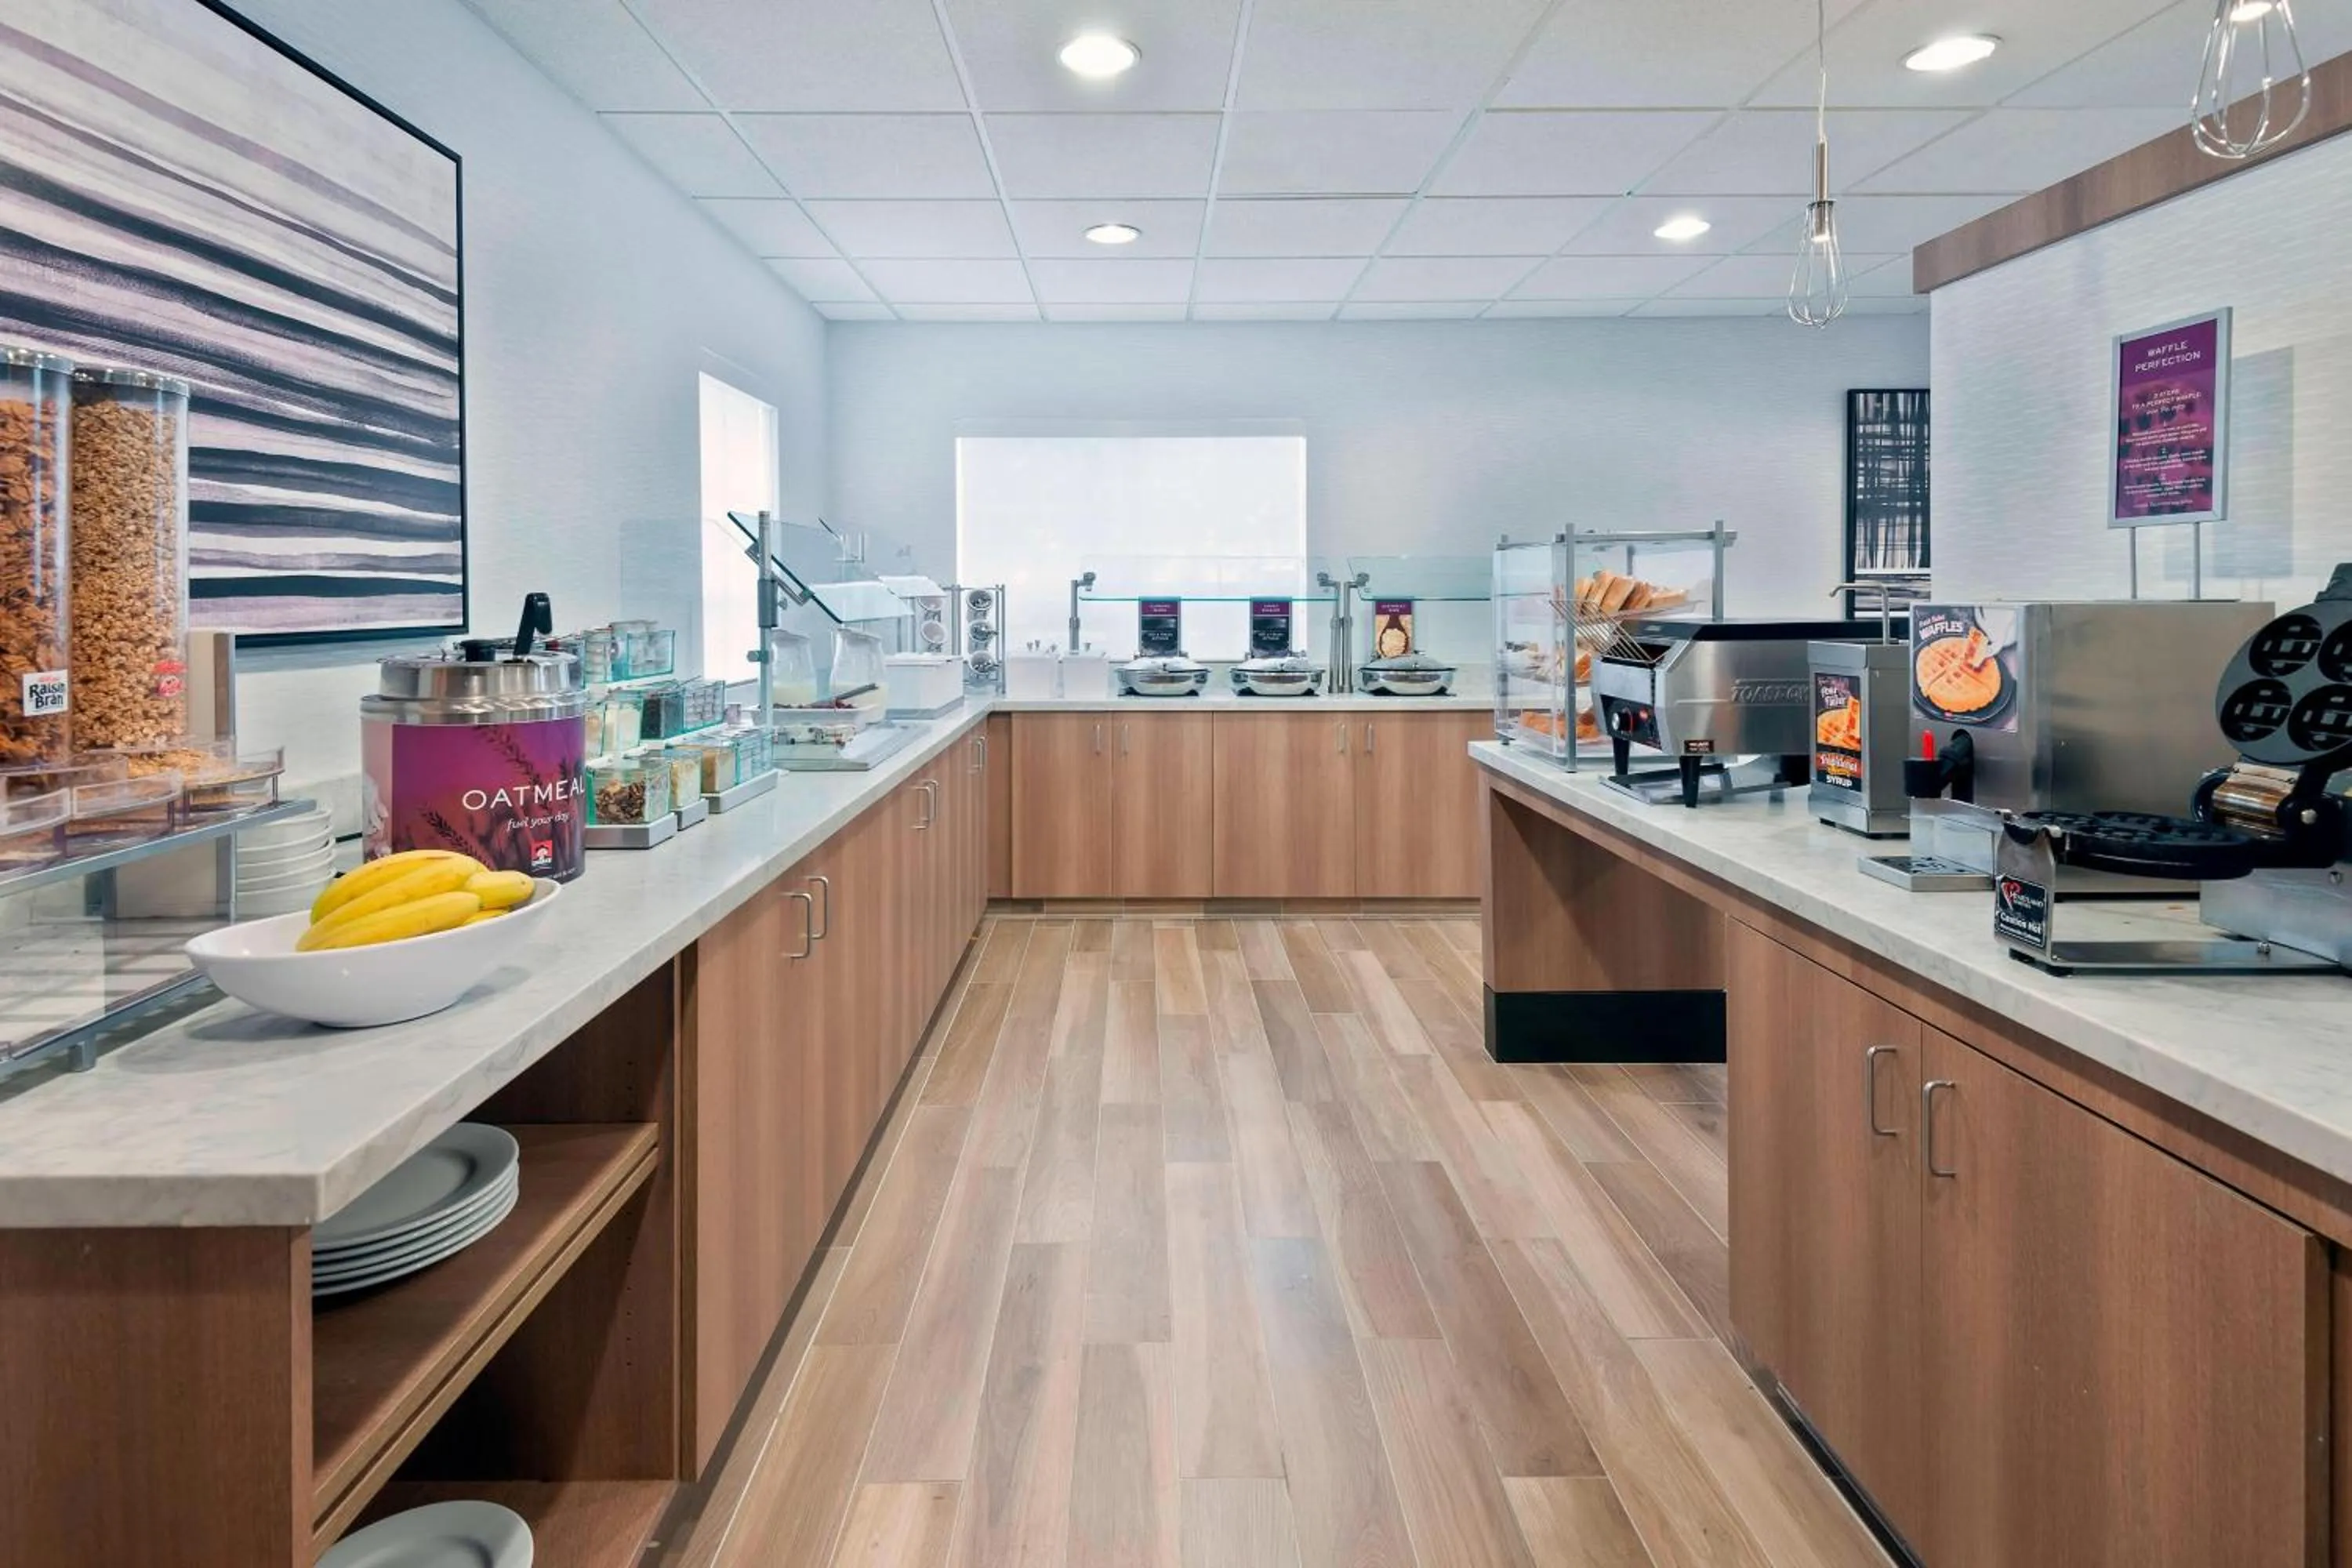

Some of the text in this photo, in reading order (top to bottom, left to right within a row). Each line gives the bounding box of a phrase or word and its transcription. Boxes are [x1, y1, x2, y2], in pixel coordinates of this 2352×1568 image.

[2147, 339, 2189, 358] WAFFLE
[2134, 350, 2201, 373] PERFECTION
[1918, 620, 1964, 641] WAFFLES
[29, 681, 66, 699] Raisin
[34, 694, 64, 710] Bran
[1826, 775, 1853, 788] SYRUP
[462, 775, 586, 811] OATMEAL
[529, 815, 554, 829] your
